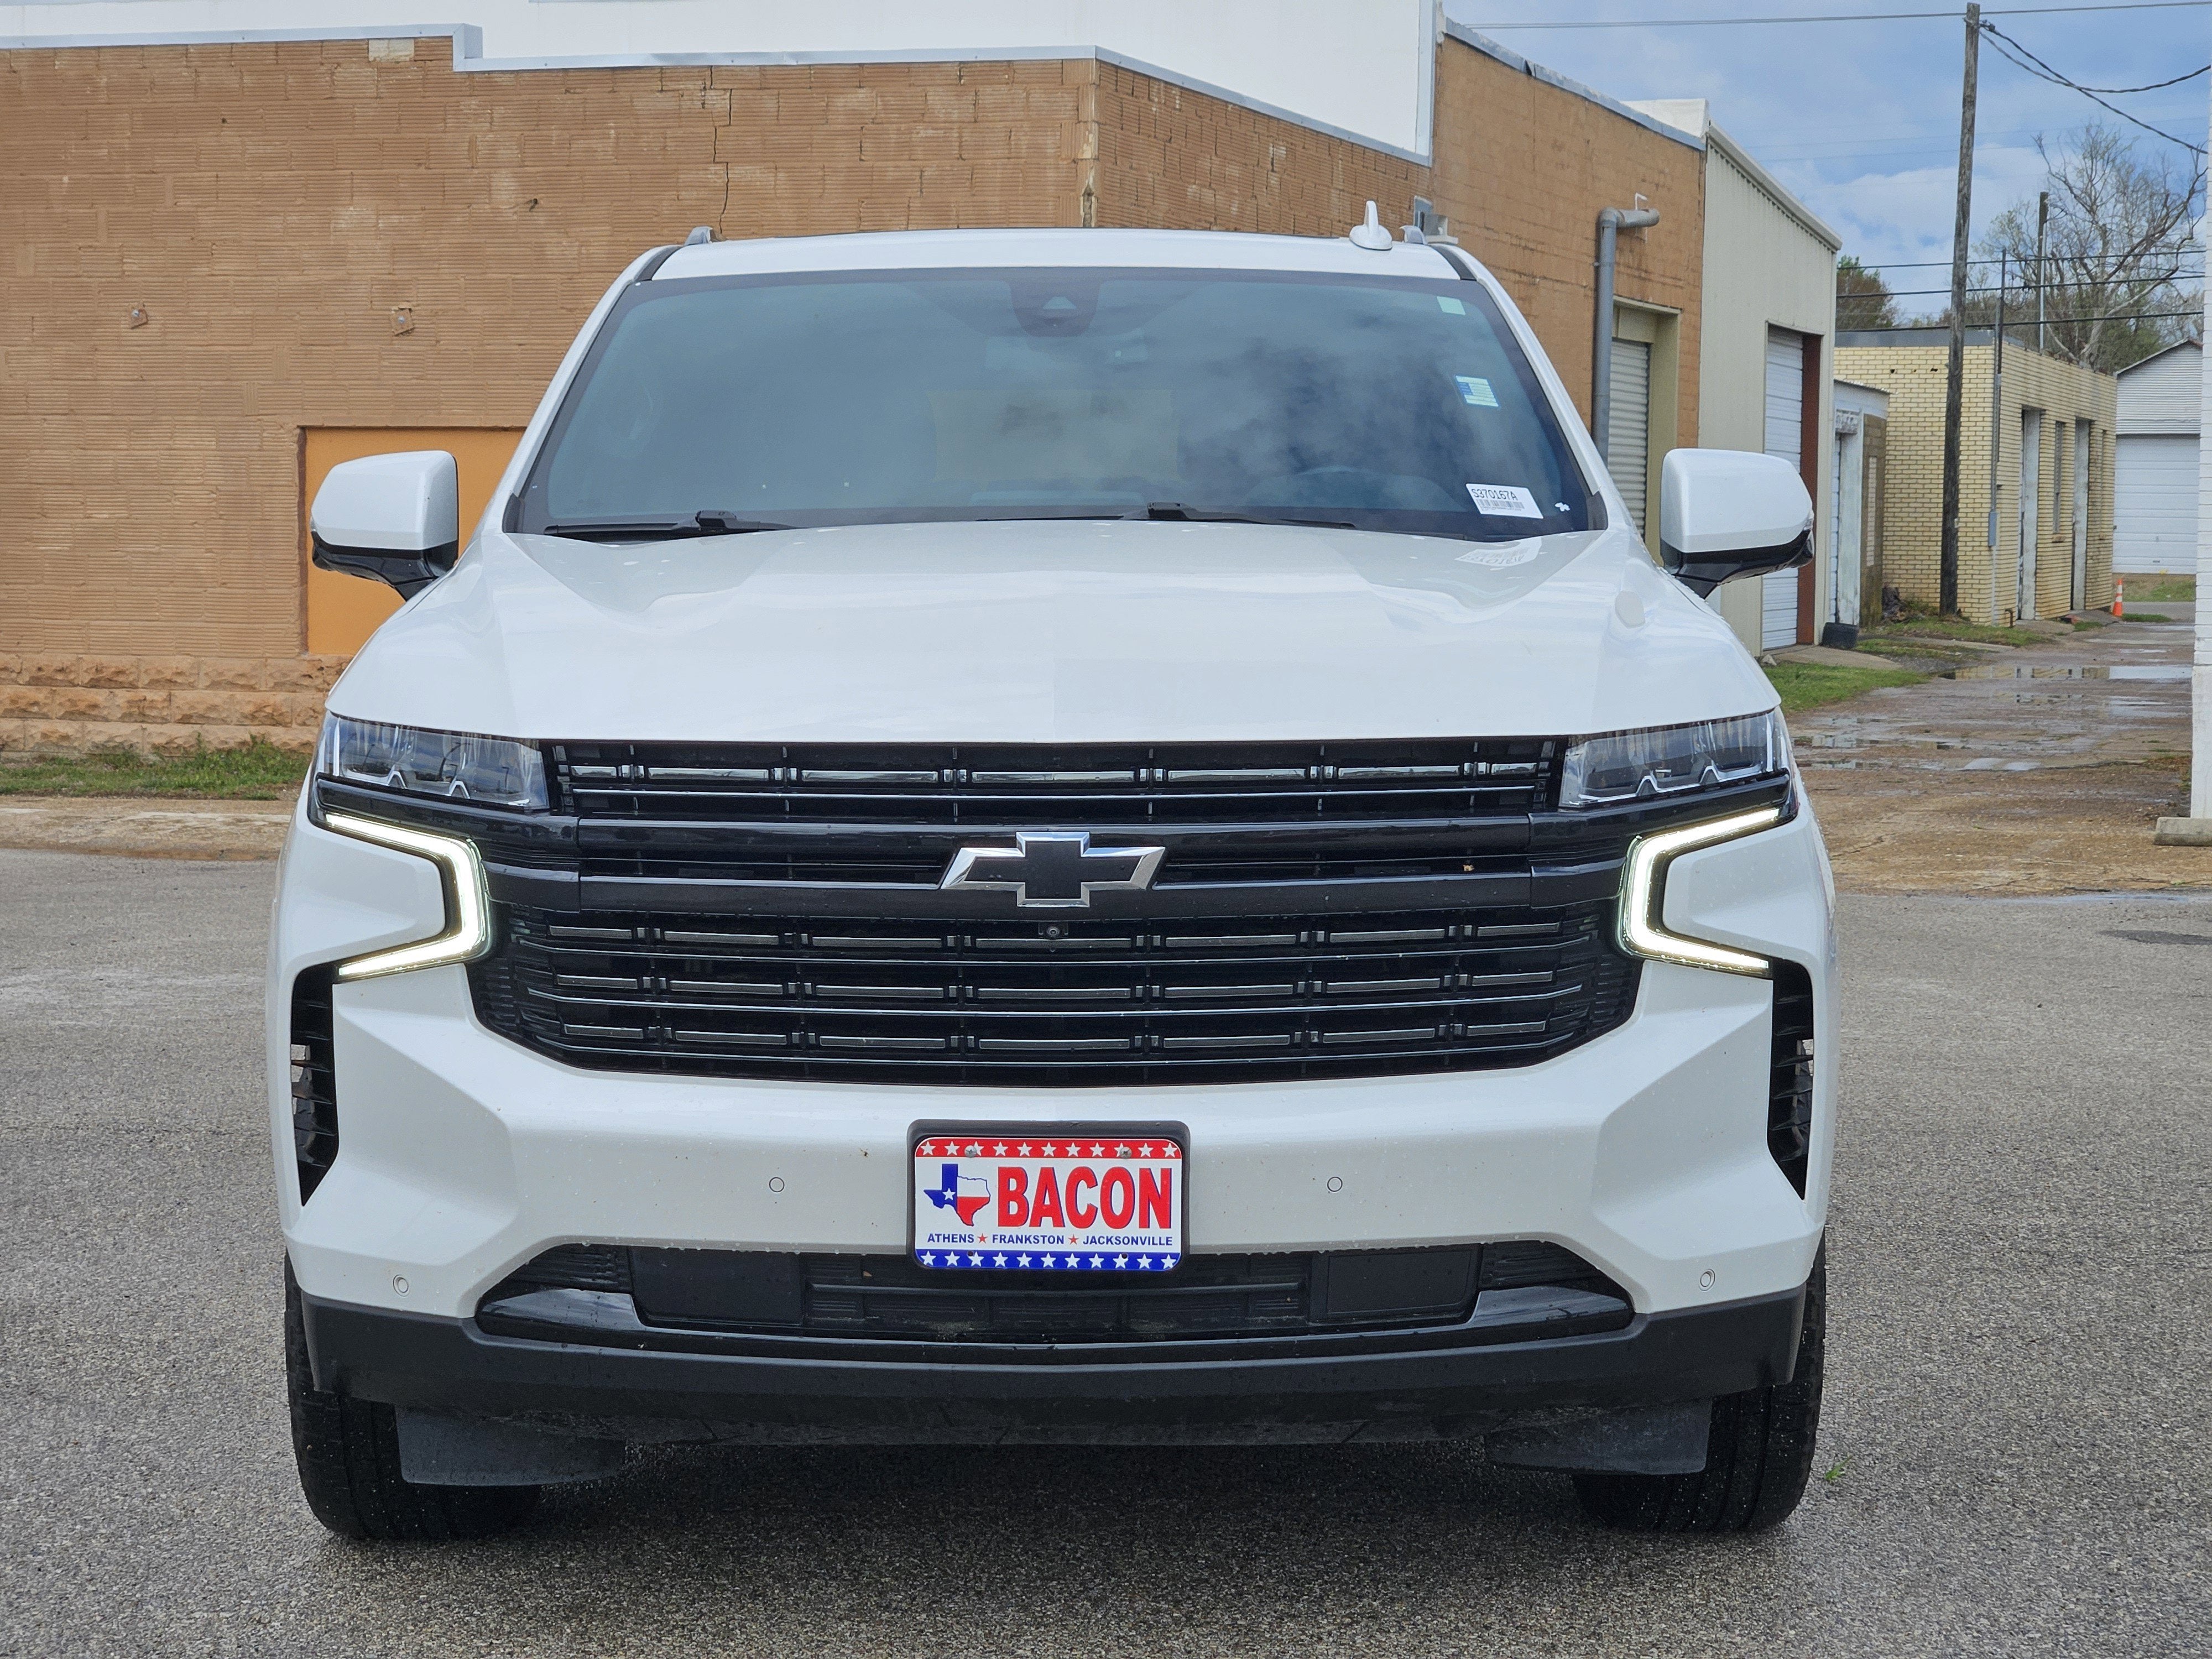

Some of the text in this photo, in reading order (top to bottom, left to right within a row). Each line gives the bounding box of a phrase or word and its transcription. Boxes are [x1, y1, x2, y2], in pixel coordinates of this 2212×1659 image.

[1471, 488, 1518, 500] S370167A
[998, 1166, 1172, 1229] BACON
[927, 1233, 1173, 1246] ATHENS FRANKSTON JACKSONVILLE
